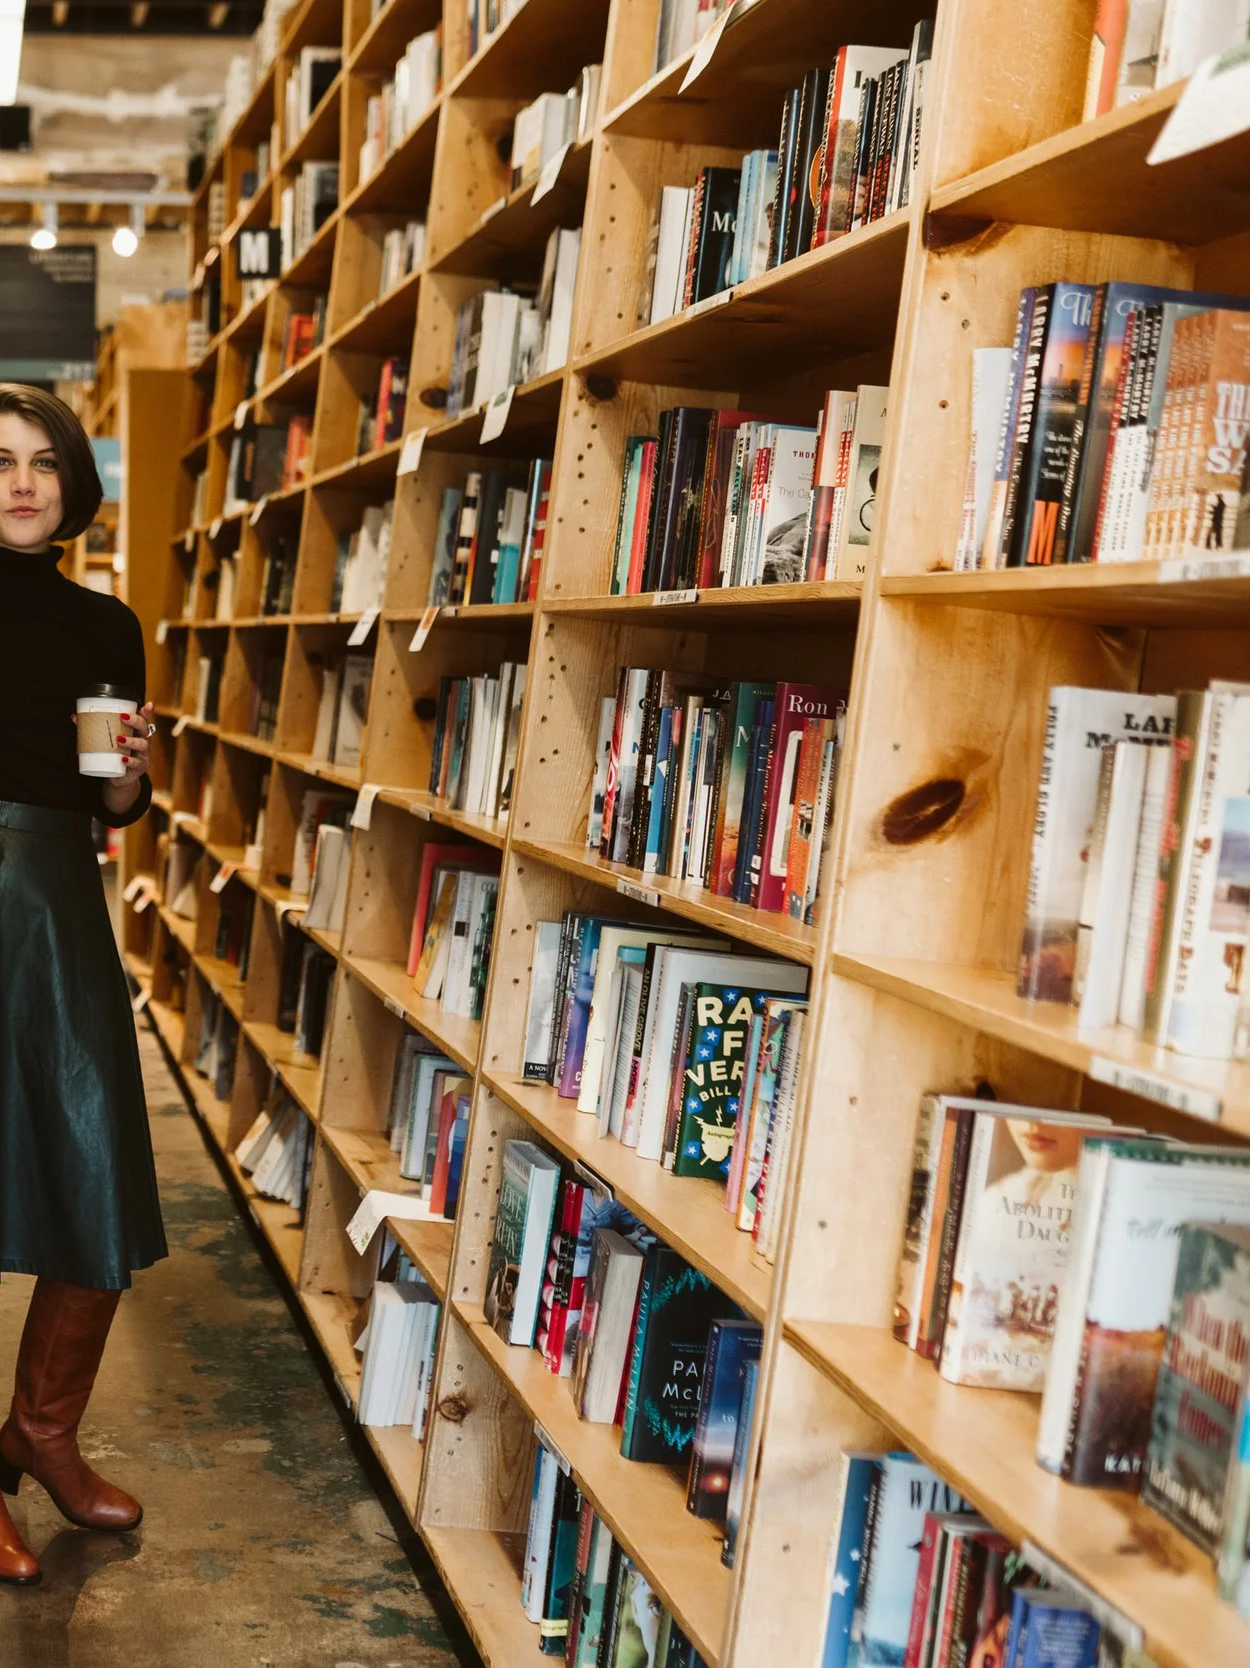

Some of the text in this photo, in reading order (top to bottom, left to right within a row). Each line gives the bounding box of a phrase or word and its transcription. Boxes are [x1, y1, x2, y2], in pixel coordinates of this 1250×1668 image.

[873, 72, 894, 197] IAN McEWAN SWEET
[240, 232, 269, 273] M
[1028, 294, 1051, 348] LARRY
[1119, 361, 1137, 421] McMURTRY
[1129, 317, 1154, 419] LARRY McMURTRY
[1139, 315, 1163, 418] LARRY McMURTRY
[1013, 352, 1043, 444] McMURTRY
[729, 437, 745, 523] LEAN FALL STAND
[750, 448, 762, 500] McGUANE
[757, 447, 768, 499] McGUANE
[778, 486, 794, 498] The
[787, 694, 830, 717] Ron
[755, 723, 778, 850] Ron McLarty Traveler
[1030, 704, 1062, 839] FOLLY AND GLORY
[627, 968, 651, 1096] AN OLIVE GROVE MOSES
[697, 996, 753, 1027] RA
[723, 1030, 744, 1056] F
[700, 1086, 732, 1102] BILL
[626, 1279, 650, 1410] PAULA McLAIN
[673, 1361, 699, 1377] PA
[972, 1351, 1022, 1367] DIANE
[722, 1413, 735, 1422] to
[862, 1484, 881, 1526] HANNA
[859, 1528, 875, 1557] WHO
